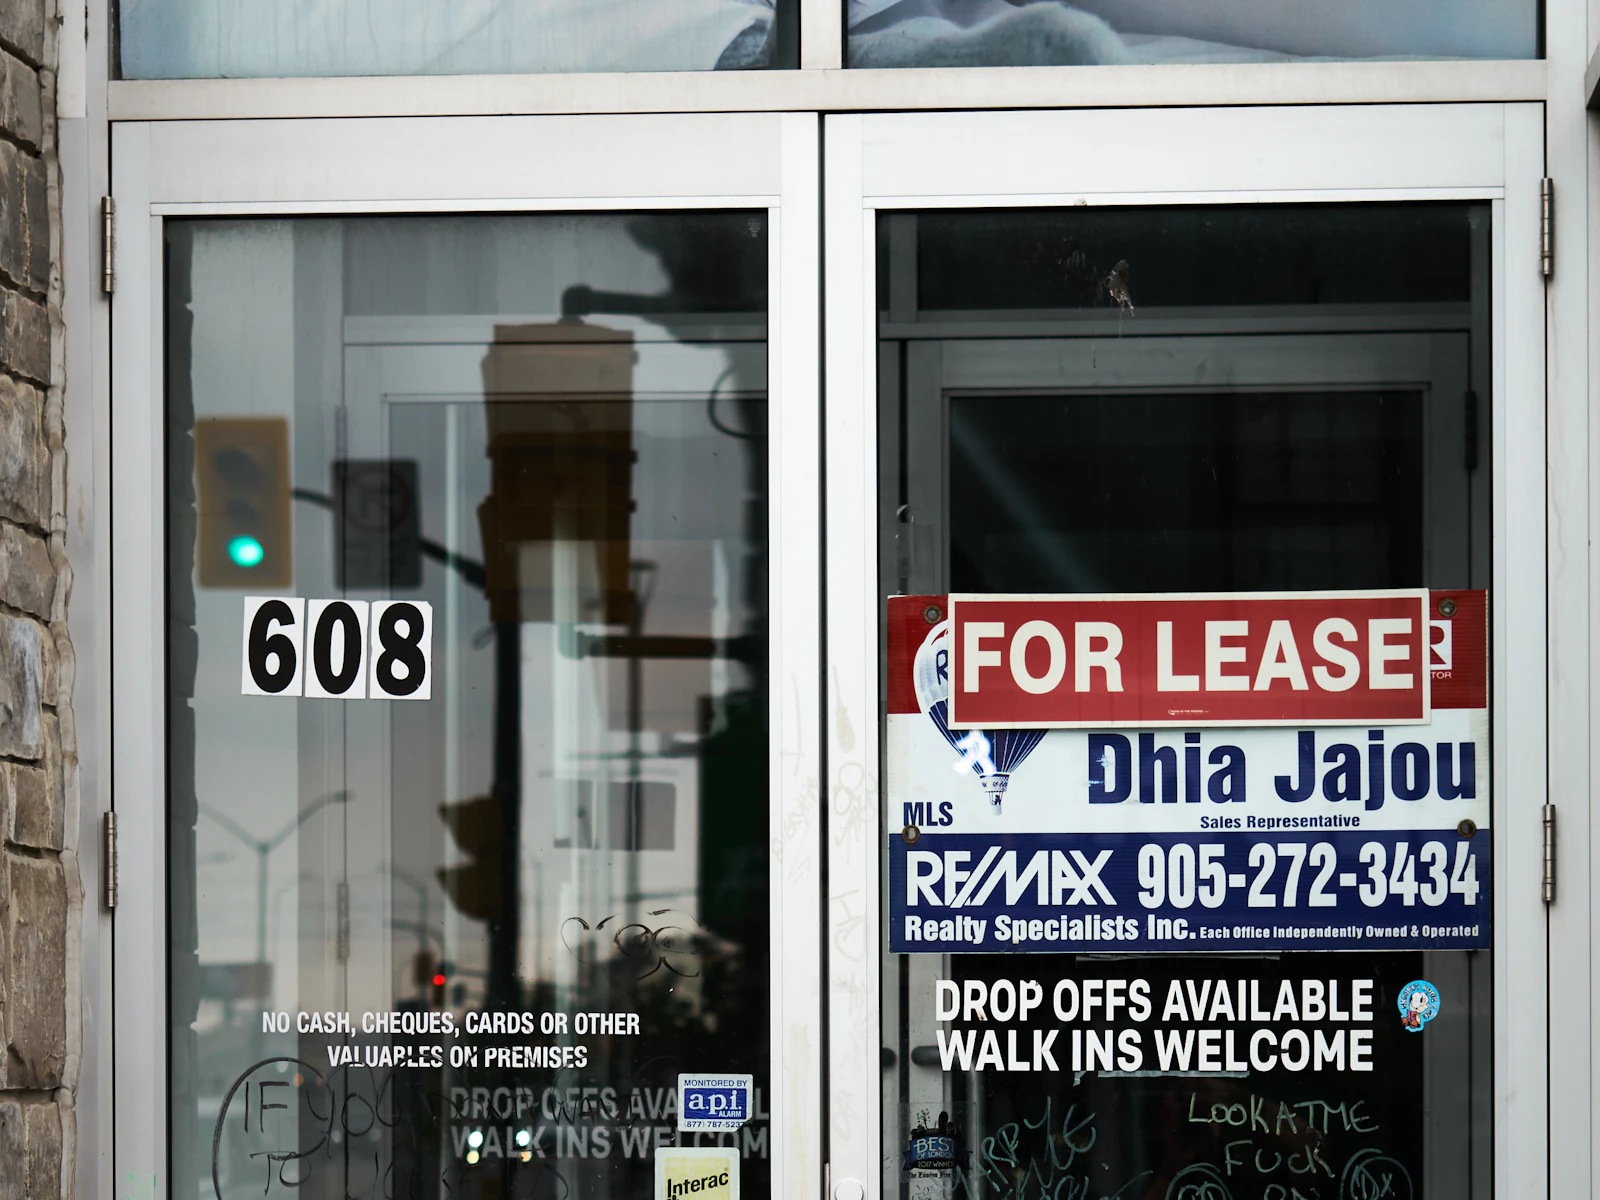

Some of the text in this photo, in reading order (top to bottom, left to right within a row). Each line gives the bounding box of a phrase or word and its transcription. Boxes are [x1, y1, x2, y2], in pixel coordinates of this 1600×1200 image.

[249, 600, 425, 696] 608
[963, 620, 1124, 694] FOR
[1157, 617, 1414, 692] LEASE
[1088, 729, 1476, 811] Dhia Jajou
[903, 802, 953, 826] MLS
[1200, 814, 1360, 829] Sales Representative
[1138, 841, 1479, 908] 905-272-3434
[905, 914, 1196, 944] Realty Specialists Inc.
[1200, 925, 1479, 939] Each Office Independently Owned & Operated
[936, 979, 1374, 1021] DROP OFFS AVAILABLE
[262, 1012, 640, 1038] NO CASH, CHEQUES, CARDS OR OTHER
[327, 1045, 588, 1068] VALUABLES ON PREMISES
[935, 1029, 1374, 1072] WALK INS WELCOME
[667, 1172, 729, 1199] Interac
